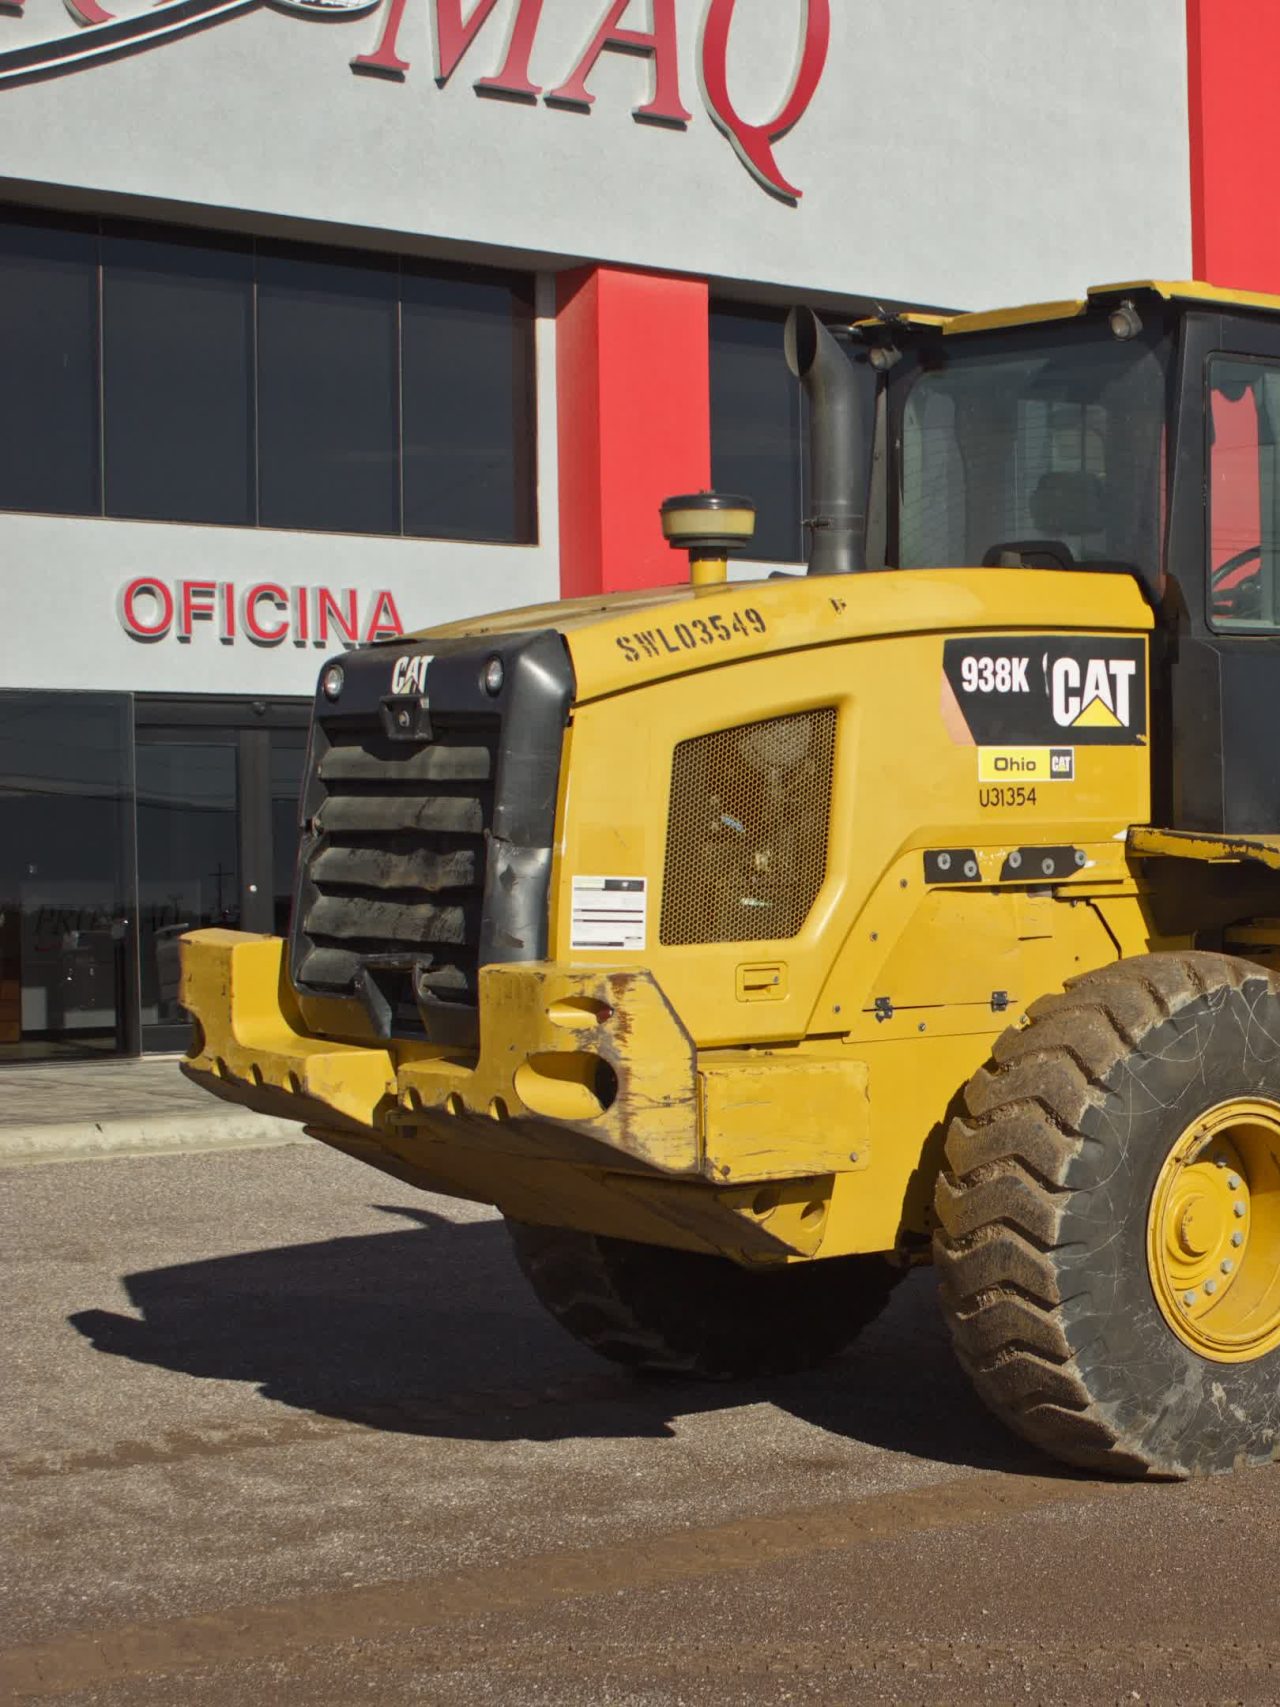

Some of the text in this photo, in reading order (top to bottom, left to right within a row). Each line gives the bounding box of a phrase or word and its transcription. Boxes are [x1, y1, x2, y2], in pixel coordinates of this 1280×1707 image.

[120, 576, 405, 646] OFICINA
[614, 607, 767, 663] SWL03549
[391, 654, 435, 695] CAT
[960, 655, 1030, 693] 938K
[1051, 657, 1137, 728] CAT
[993, 755, 1072, 772] Ohio CAT
[978, 786, 1037, 807] U31354
